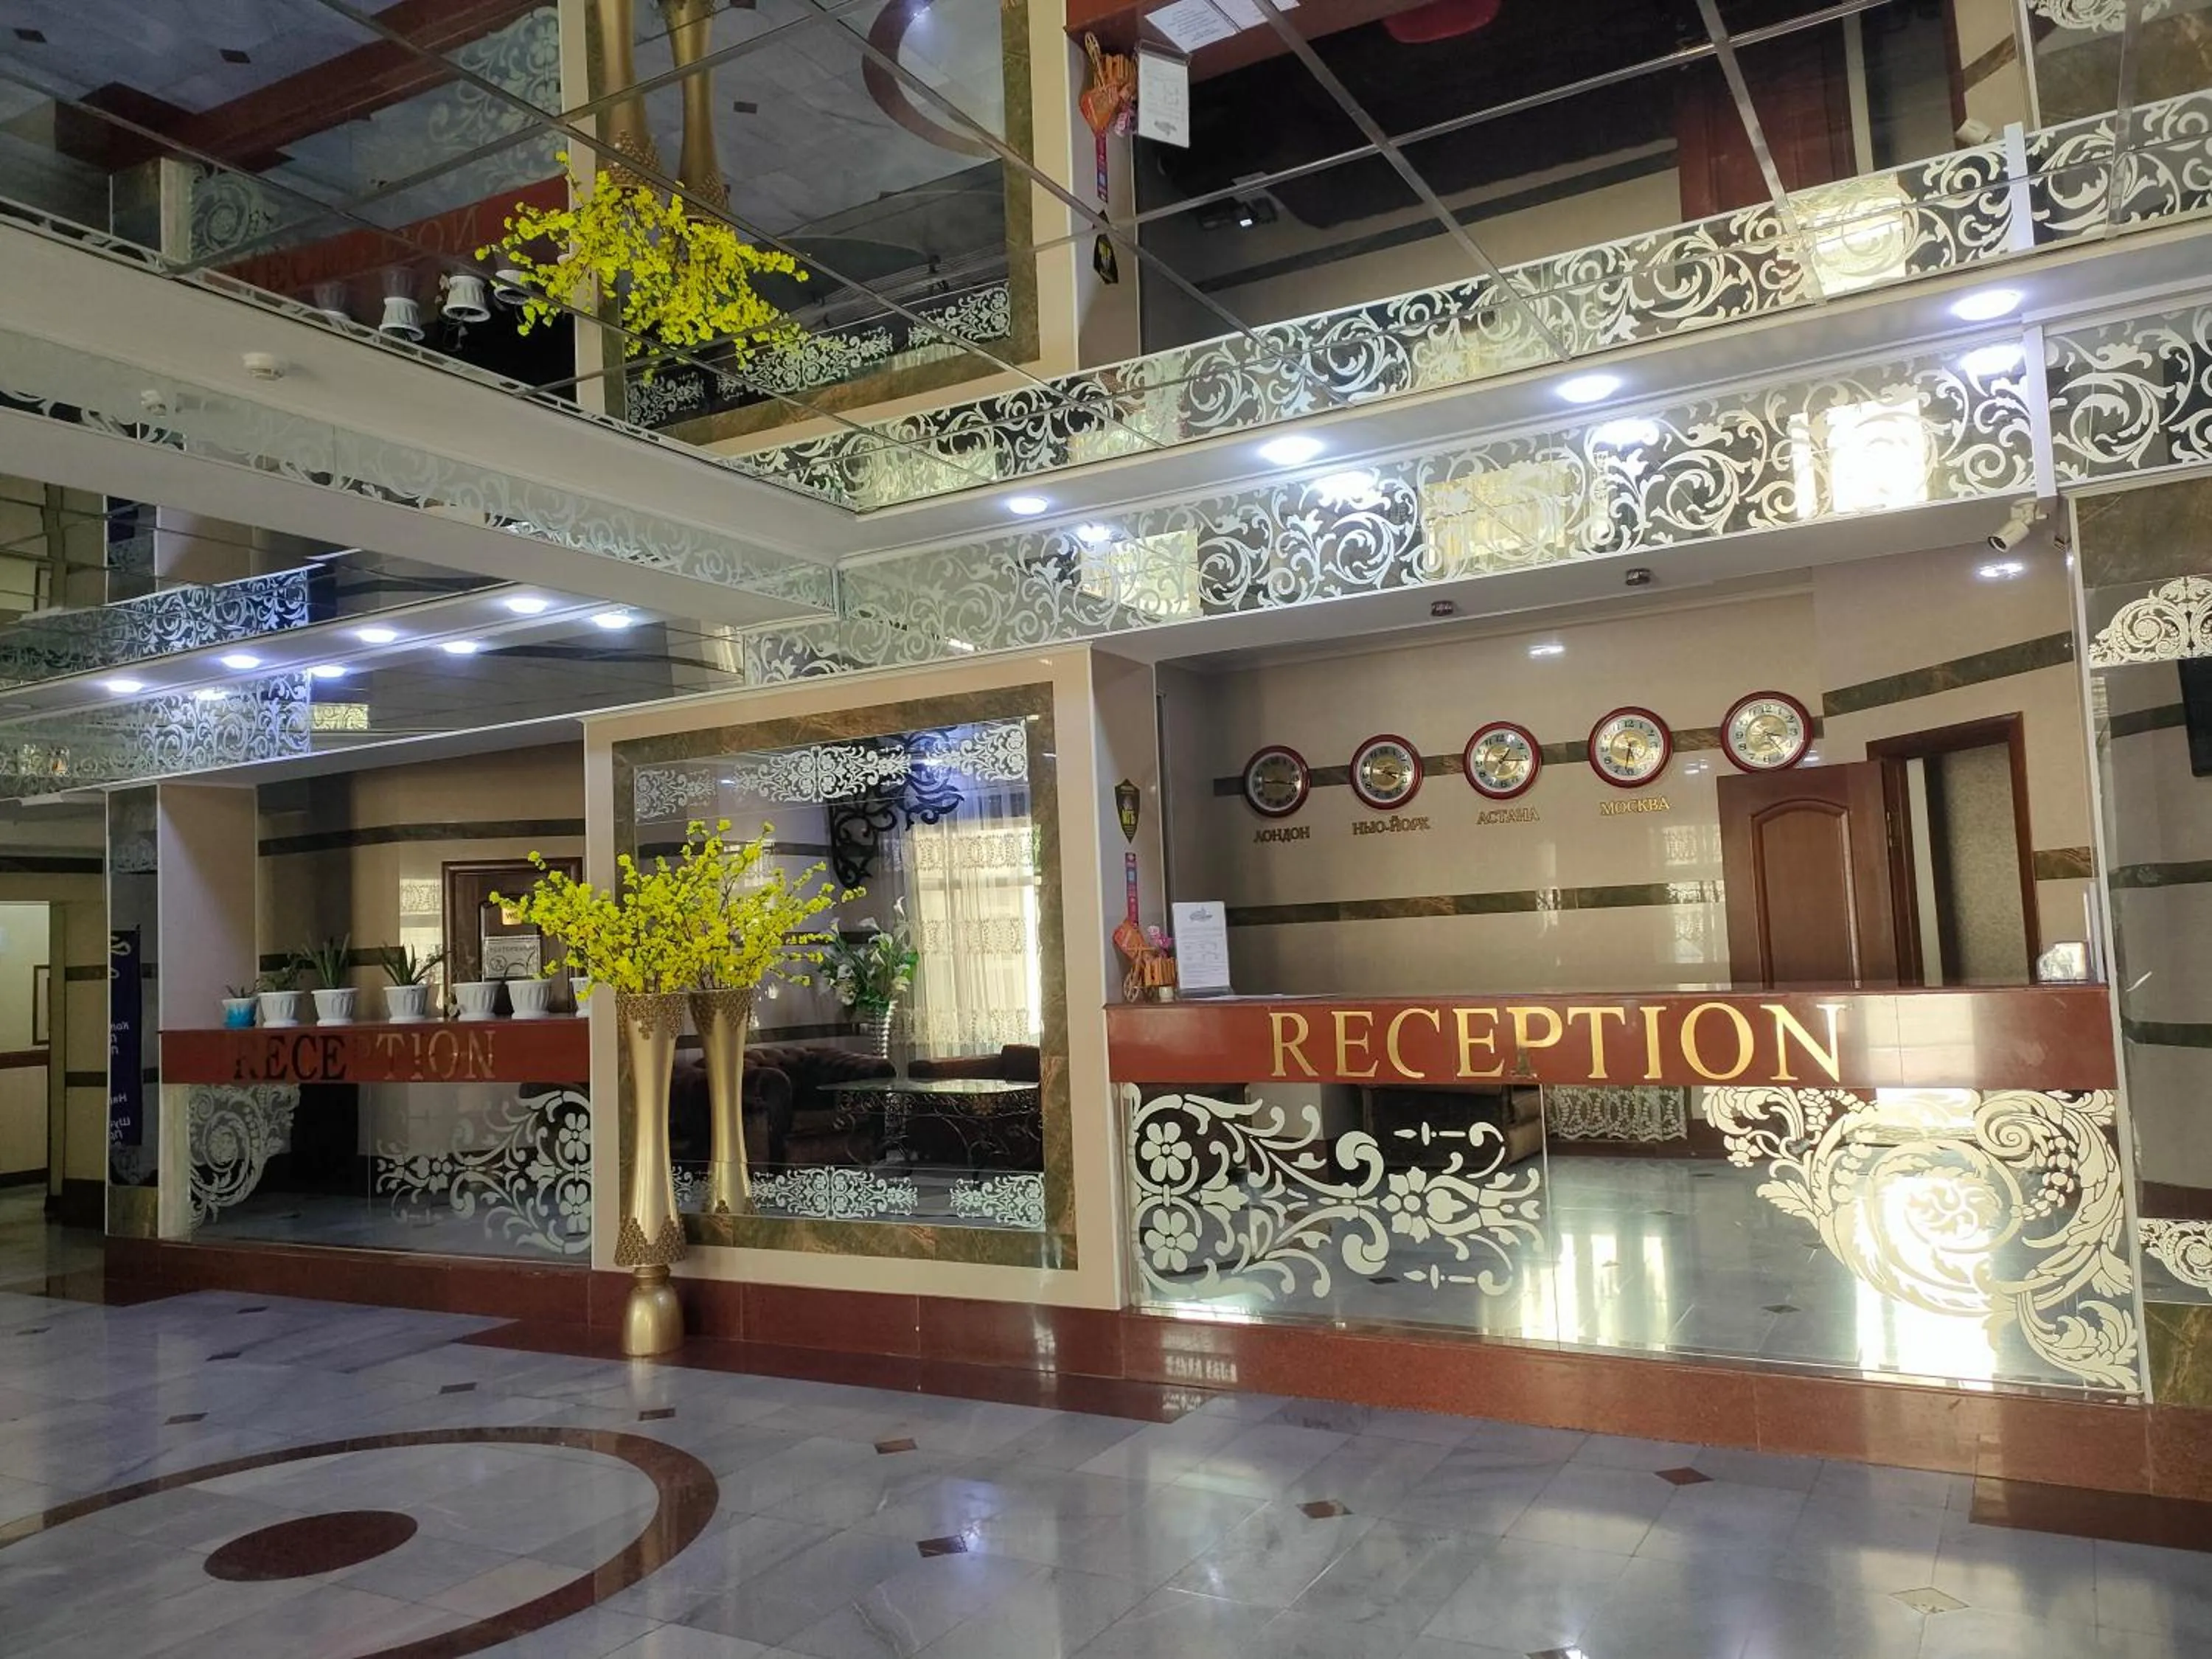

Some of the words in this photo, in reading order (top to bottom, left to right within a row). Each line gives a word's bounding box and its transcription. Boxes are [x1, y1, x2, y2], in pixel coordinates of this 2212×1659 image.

[1476, 807, 1541, 825] АСТАНА
[1600, 796, 1671, 816] МОСКВА
[1253, 826, 1311, 844] ЛОНДОН
[1352, 815, 1431, 835] НЬЮ-ЙОРК
[1270, 1002, 1847, 1082] RECEPTION
